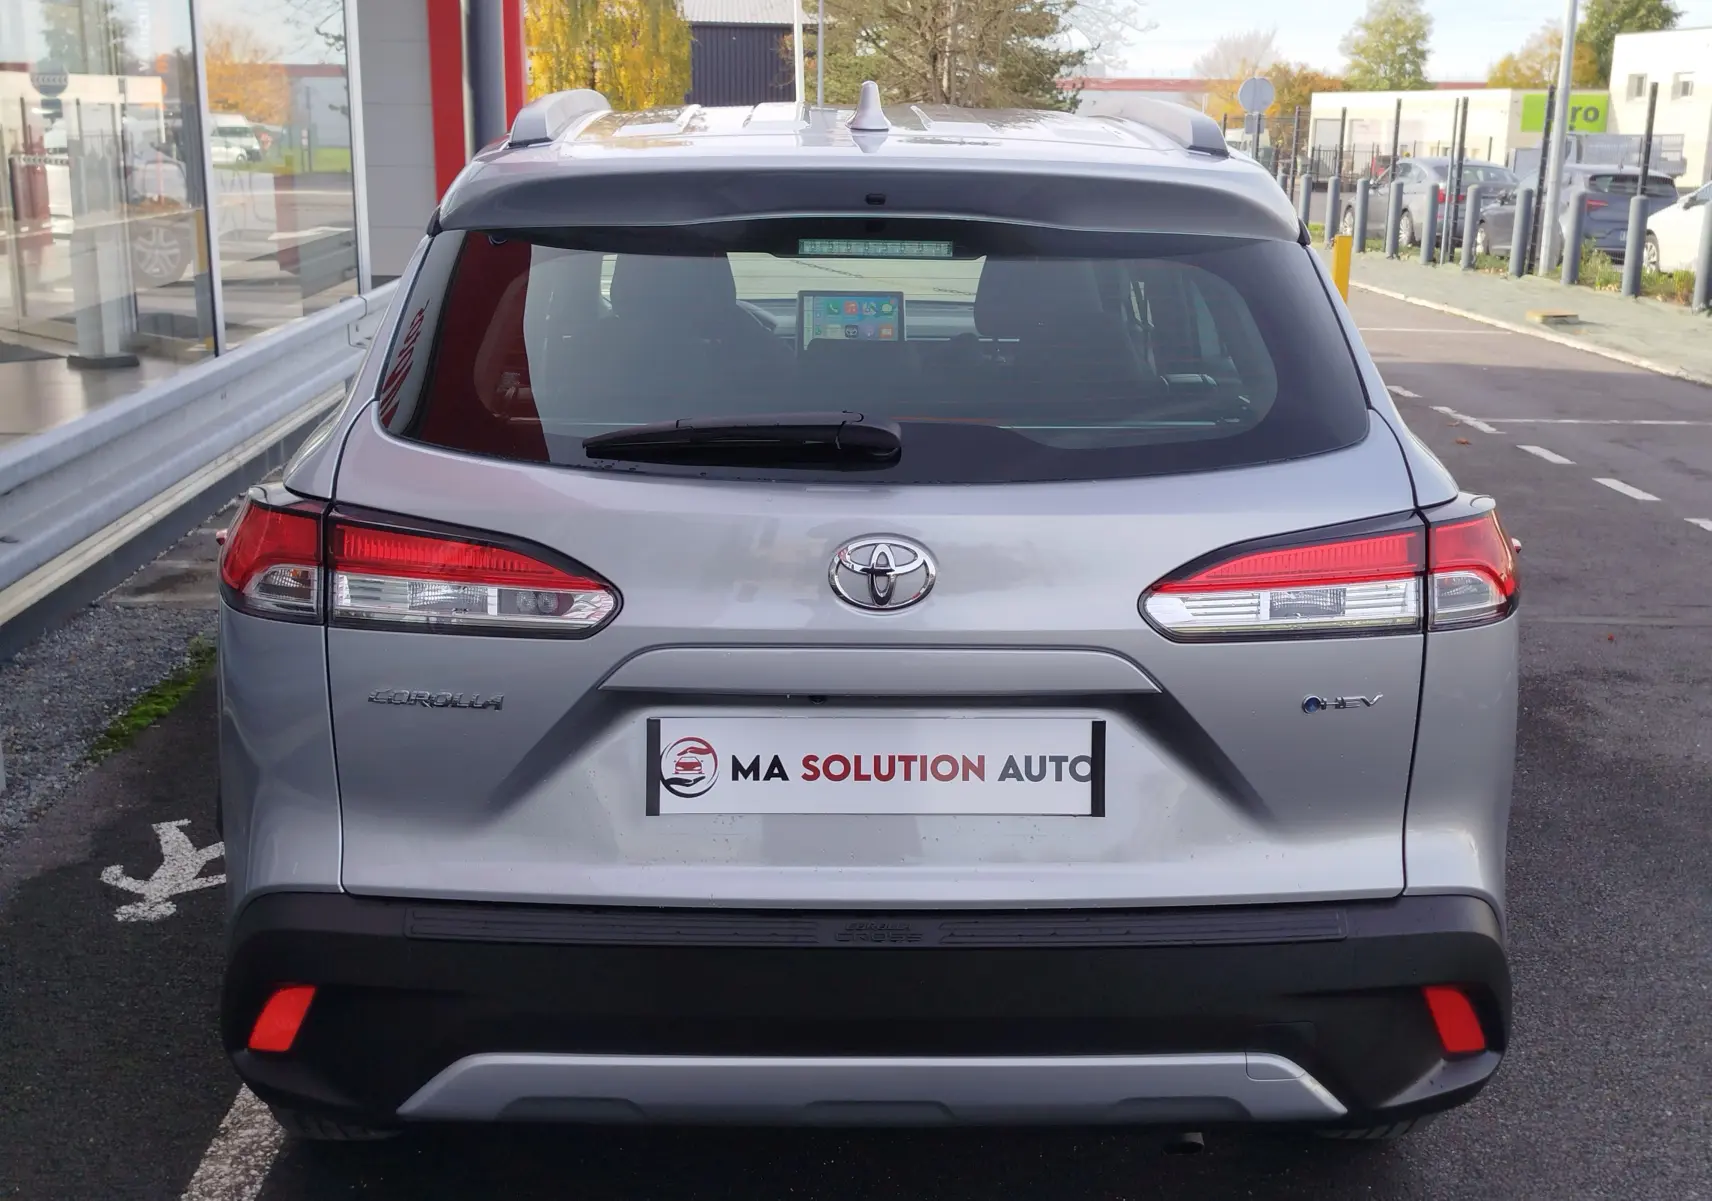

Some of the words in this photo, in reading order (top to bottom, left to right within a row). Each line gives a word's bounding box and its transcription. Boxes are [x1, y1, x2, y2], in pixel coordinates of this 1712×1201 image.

[368, 688, 505, 712] COROLLA
[731, 754, 790, 782] MA
[801, 754, 985, 782] SOLUTION
[997, 754, 1092, 782] AUTO
[835, 932, 923, 943] CROSS
